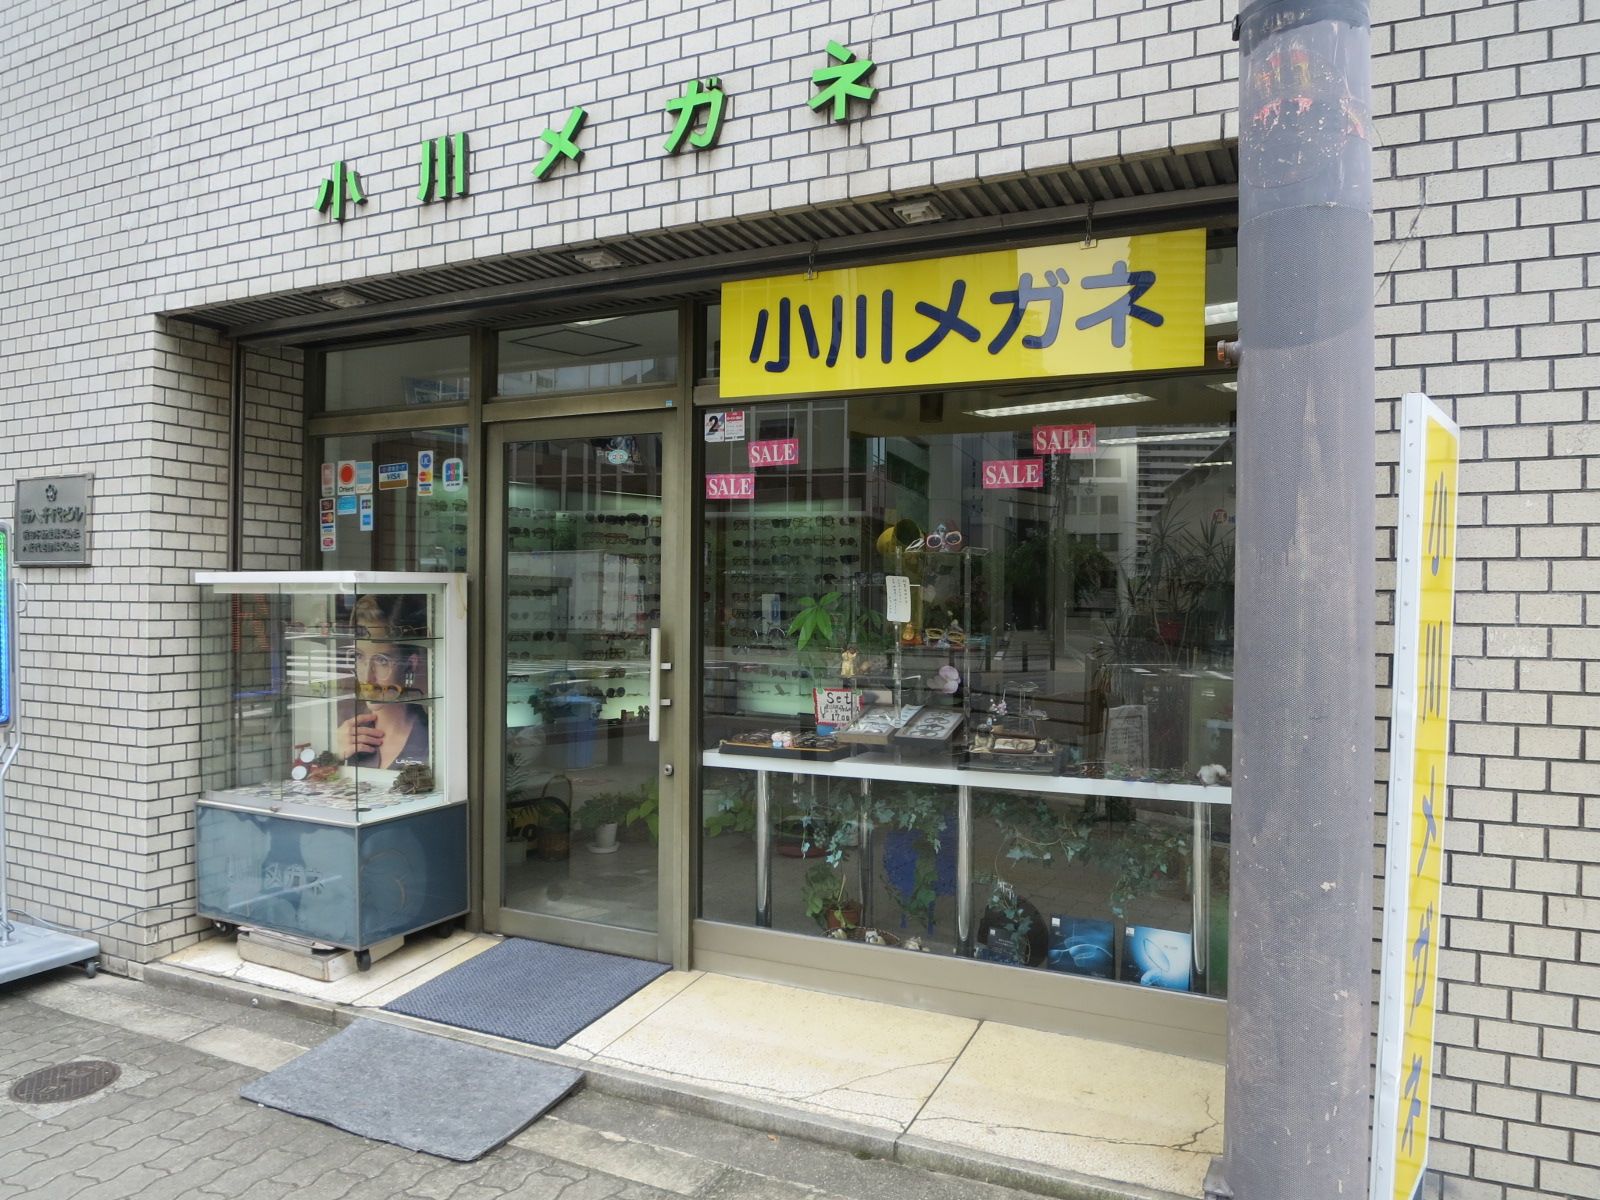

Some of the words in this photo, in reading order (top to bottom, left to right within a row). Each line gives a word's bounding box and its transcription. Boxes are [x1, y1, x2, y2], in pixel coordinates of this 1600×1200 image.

[312, 39, 879, 221] 小川メガネ
[749, 260, 1165, 373] 小川メガネ
[1036, 429, 1092, 451] SALE
[750, 443, 796, 464] SALE
[386, 472, 401, 480] VISA
[985, 464, 1040, 485] SALE
[707, 477, 753, 496] SALE
[826, 692, 852, 704] Set
[1400, 472, 1449, 1160] 小川メガネ
